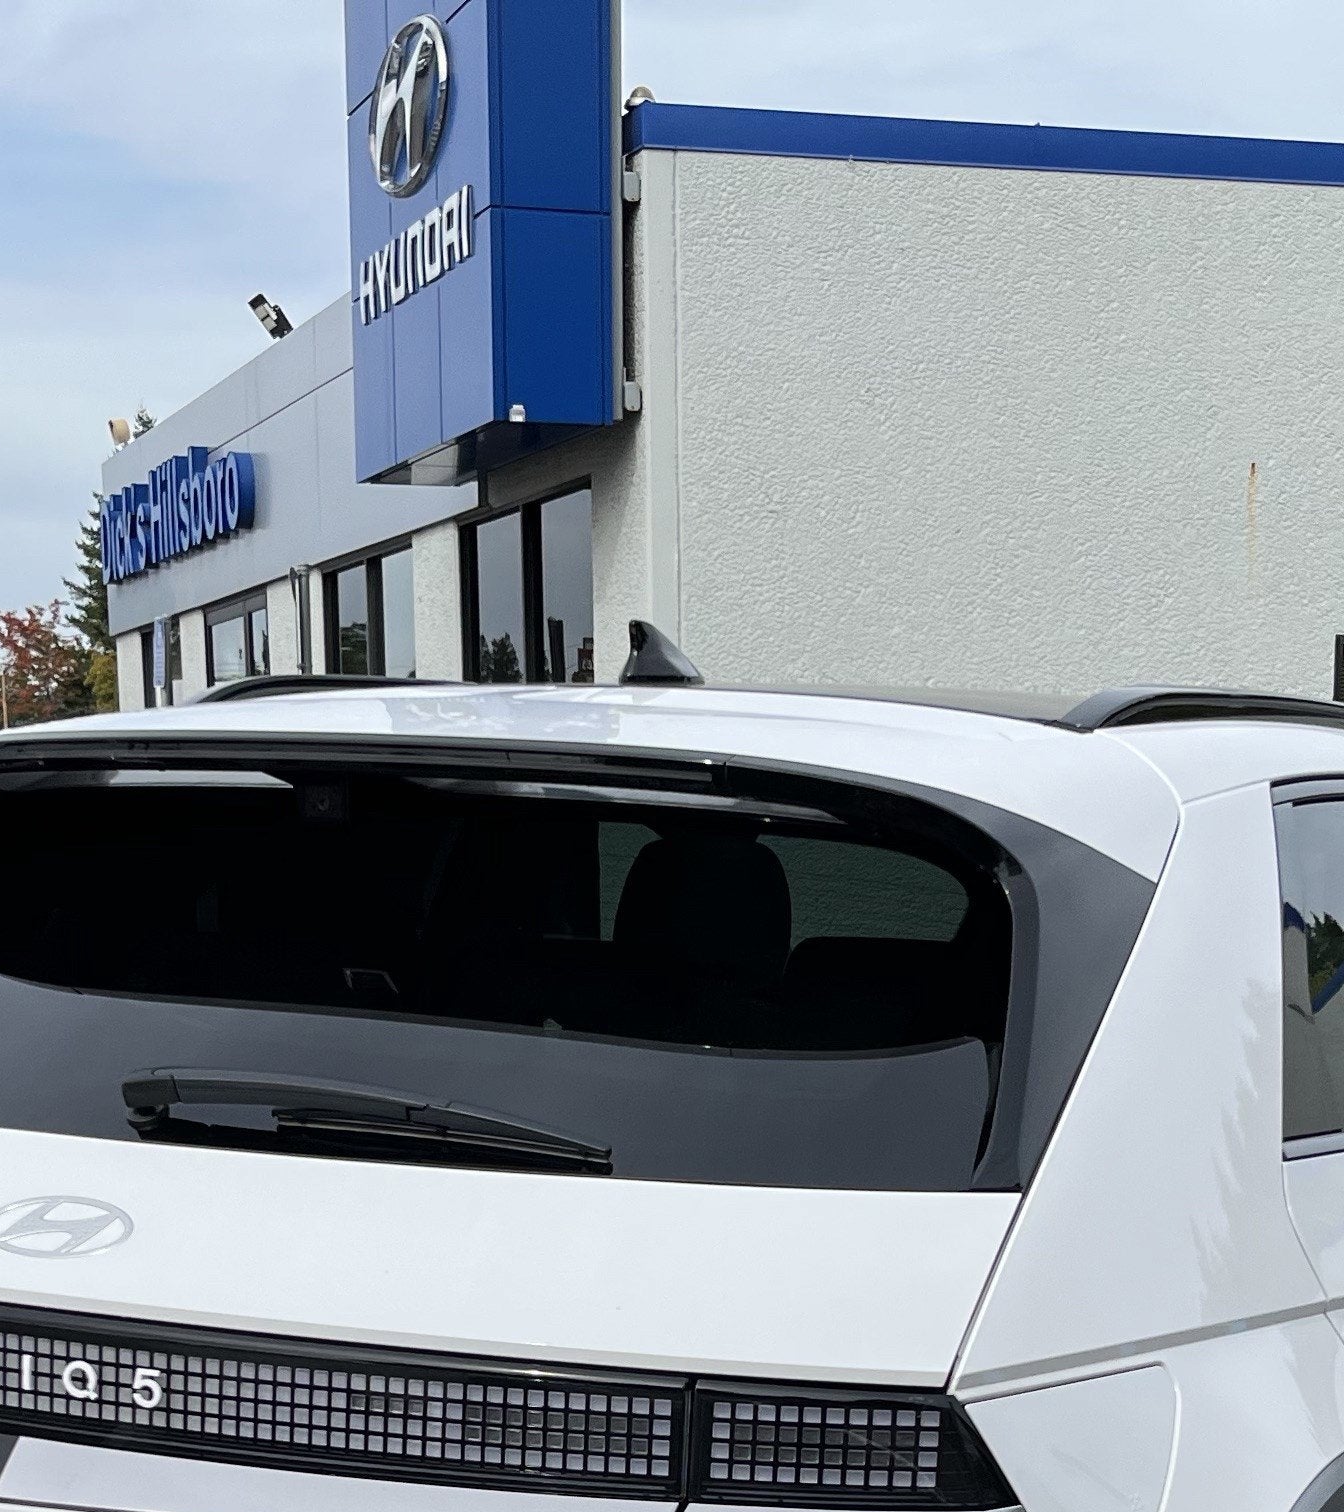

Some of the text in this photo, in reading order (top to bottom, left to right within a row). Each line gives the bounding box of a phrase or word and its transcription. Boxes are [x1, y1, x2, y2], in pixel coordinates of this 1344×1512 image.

[359, 185, 472, 325] HYUNDAI
[101, 446, 246, 585] Dick's Hillsboro
[132, 1368, 164, 1409] 5
